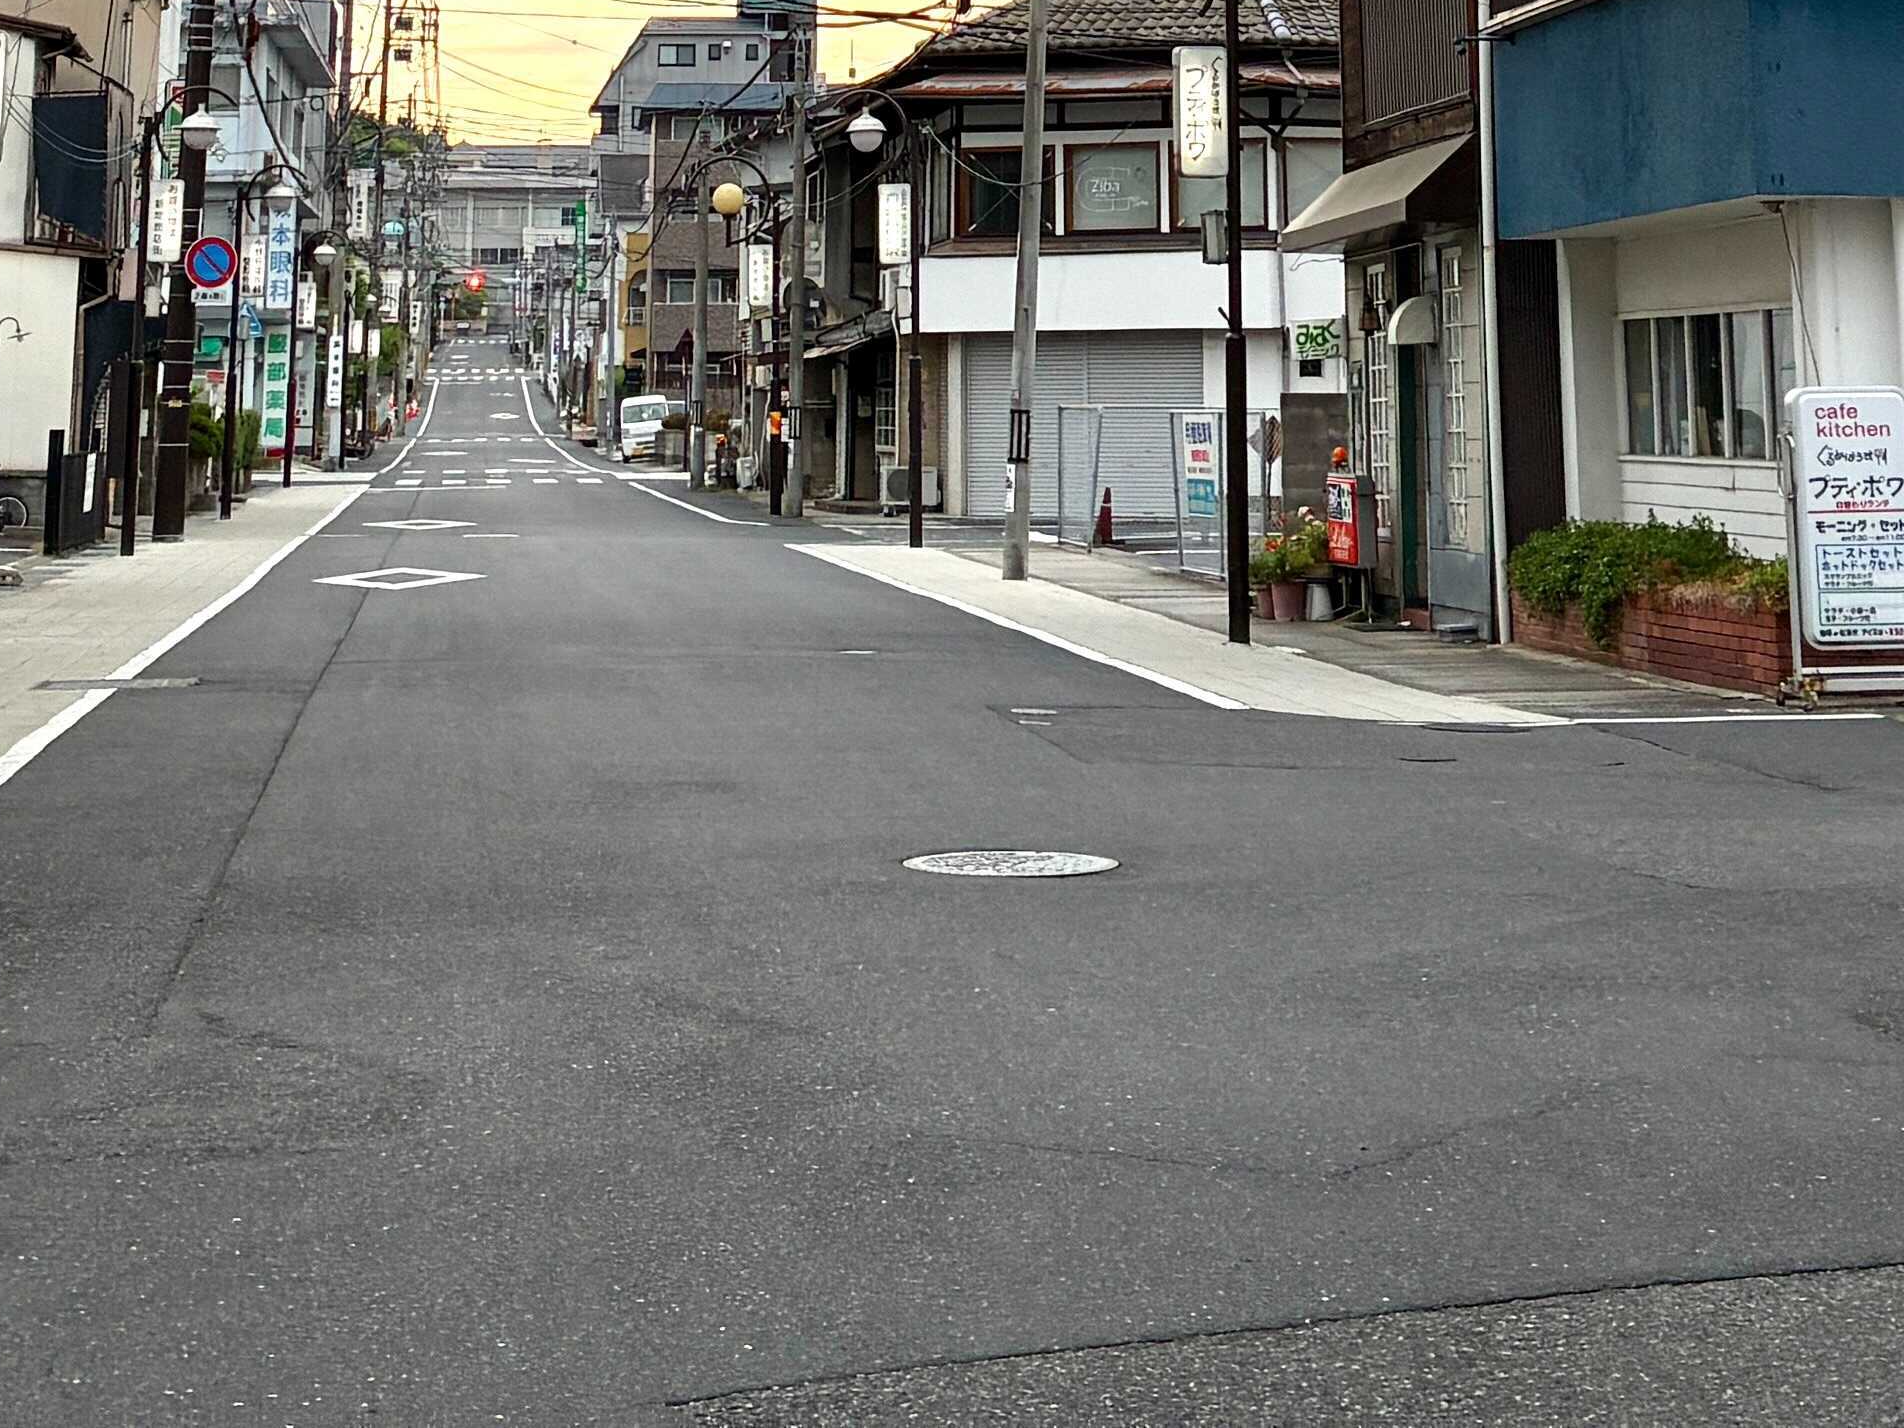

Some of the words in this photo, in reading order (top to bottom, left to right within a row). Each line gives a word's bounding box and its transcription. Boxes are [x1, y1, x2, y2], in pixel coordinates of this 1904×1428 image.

[1815, 403, 1859, 420] cafe
[1816, 421, 1892, 438] kitchen
[1808, 474, 1904, 500] プティ・ポワ
[1822, 547, 1903, 560] トーストセット
